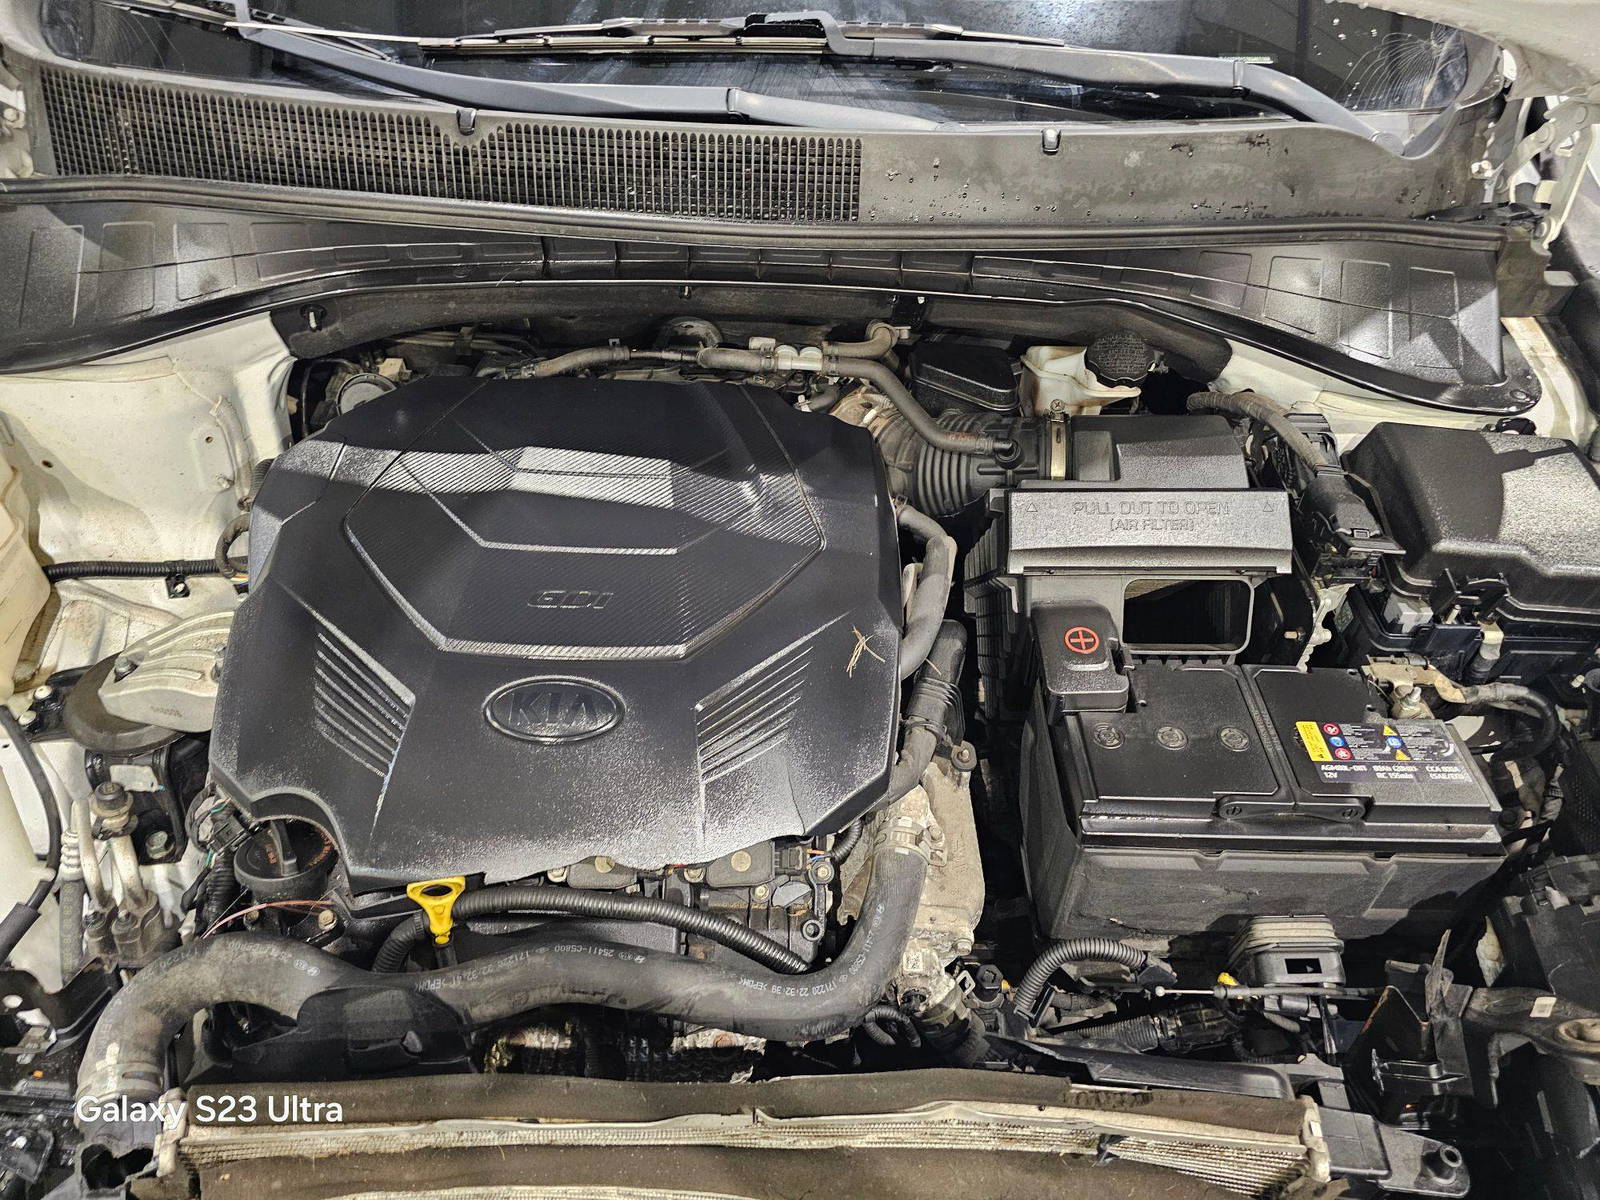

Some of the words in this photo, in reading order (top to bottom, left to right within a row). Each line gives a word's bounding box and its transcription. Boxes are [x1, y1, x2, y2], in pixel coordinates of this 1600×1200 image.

[1073, 501, 1112, 515] PULL
[1119, 501, 1151, 515] OUT
[1158, 501, 1180, 515] TO
[1184, 501, 1230, 515] OPEN
[527, 590, 615, 609] GDI
[508, 690, 600, 726] KIA
